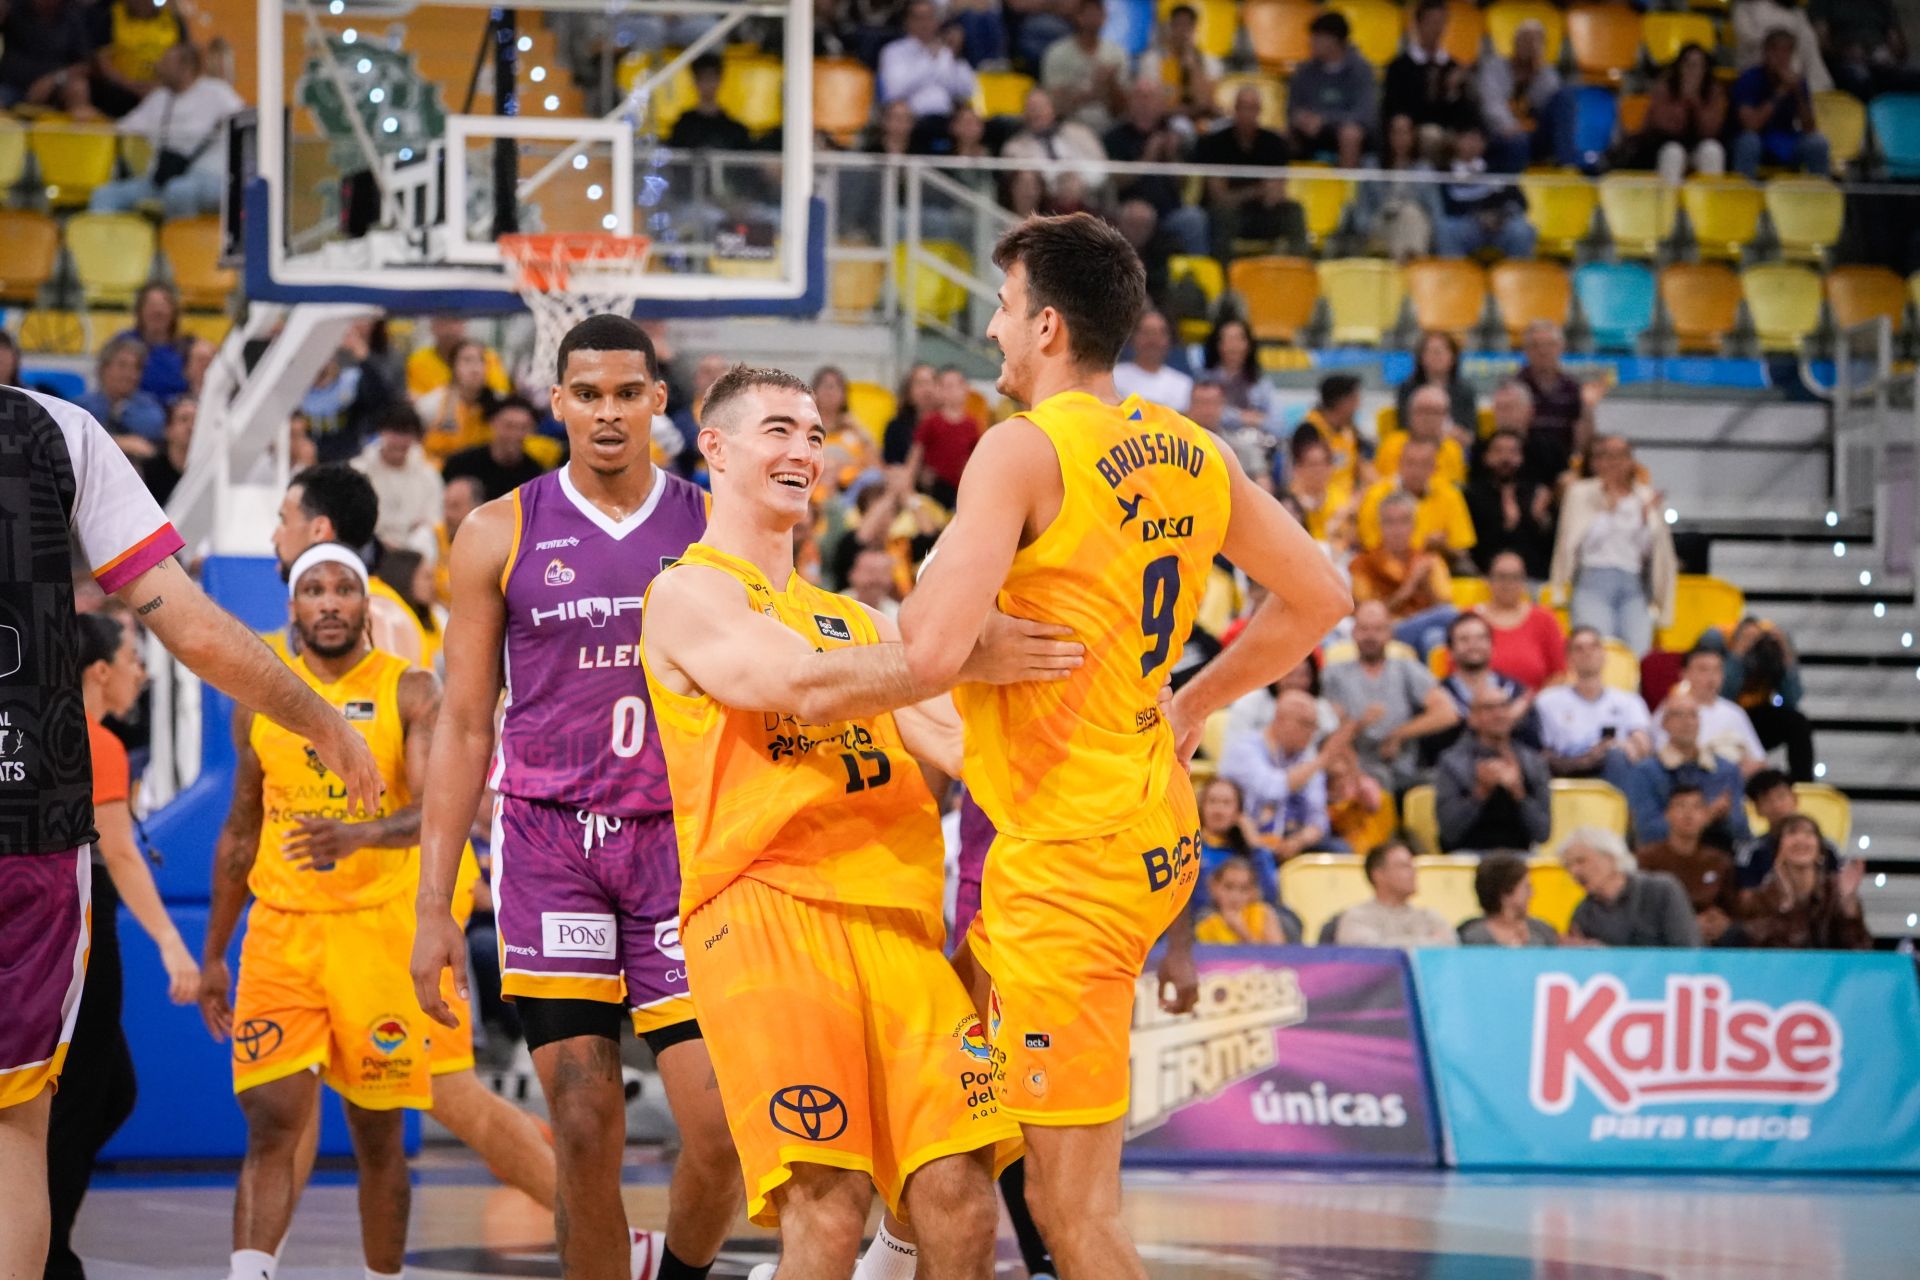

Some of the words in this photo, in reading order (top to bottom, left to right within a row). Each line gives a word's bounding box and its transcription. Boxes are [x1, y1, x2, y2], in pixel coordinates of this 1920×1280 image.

[1095, 433, 1205, 490] BRUSSINO
[1140, 554, 1180, 679] 9
[612, 696, 647, 758] 0
[557, 924, 607, 946] PONS
[1026, 1036, 1046, 1047] acb
[1534, 977, 1838, 1108] Kalise
[967, 1086, 996, 1108] del
[1252, 1081, 1408, 1128] únicas
[1590, 1114, 1686, 1141] para
[1693, 1115, 1812, 1141] todos
